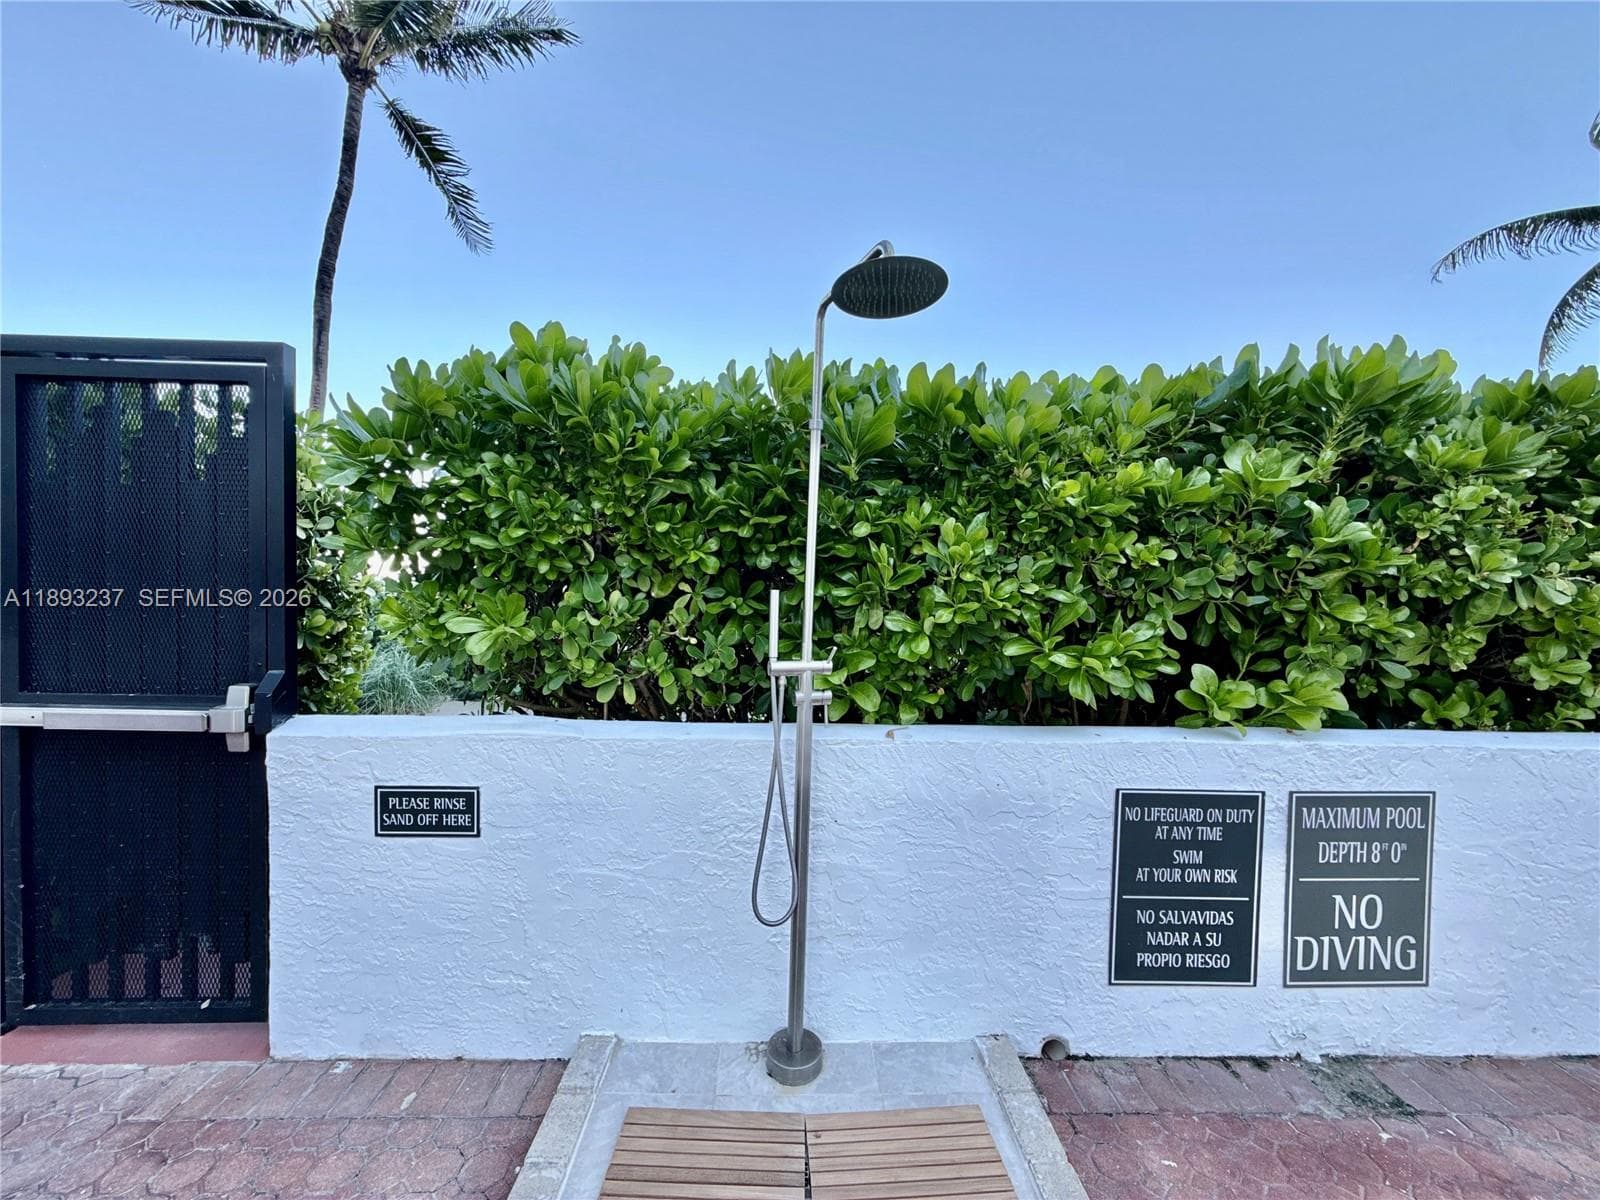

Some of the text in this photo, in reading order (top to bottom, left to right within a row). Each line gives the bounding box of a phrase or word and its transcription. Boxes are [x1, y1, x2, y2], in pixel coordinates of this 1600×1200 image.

[388, 797, 467, 810] PLEASE RINSE
[383, 813, 472, 826] SAND OFF HERE
[1125, 807, 1256, 824] NO LIFEGUARD ON DUTY
[1302, 807, 1425, 829] MAXIMUM POOL
[1154, 826, 1223, 841] AT ANY TIME
[1172, 849, 1203, 865] SWIM
[1318, 841, 1367, 864] DEPTH
[1135, 868, 1238, 884] AT YOUR OWN RISK
[1136, 909, 1234, 926] NO SALVAVIDAS
[1331, 894, 1384, 930] NO
[1146, 931, 1222, 947] NADAR A SU
[1136, 952, 1231, 969] PROPIO RIESGO
[1293, 935, 1417, 971] DIVING
